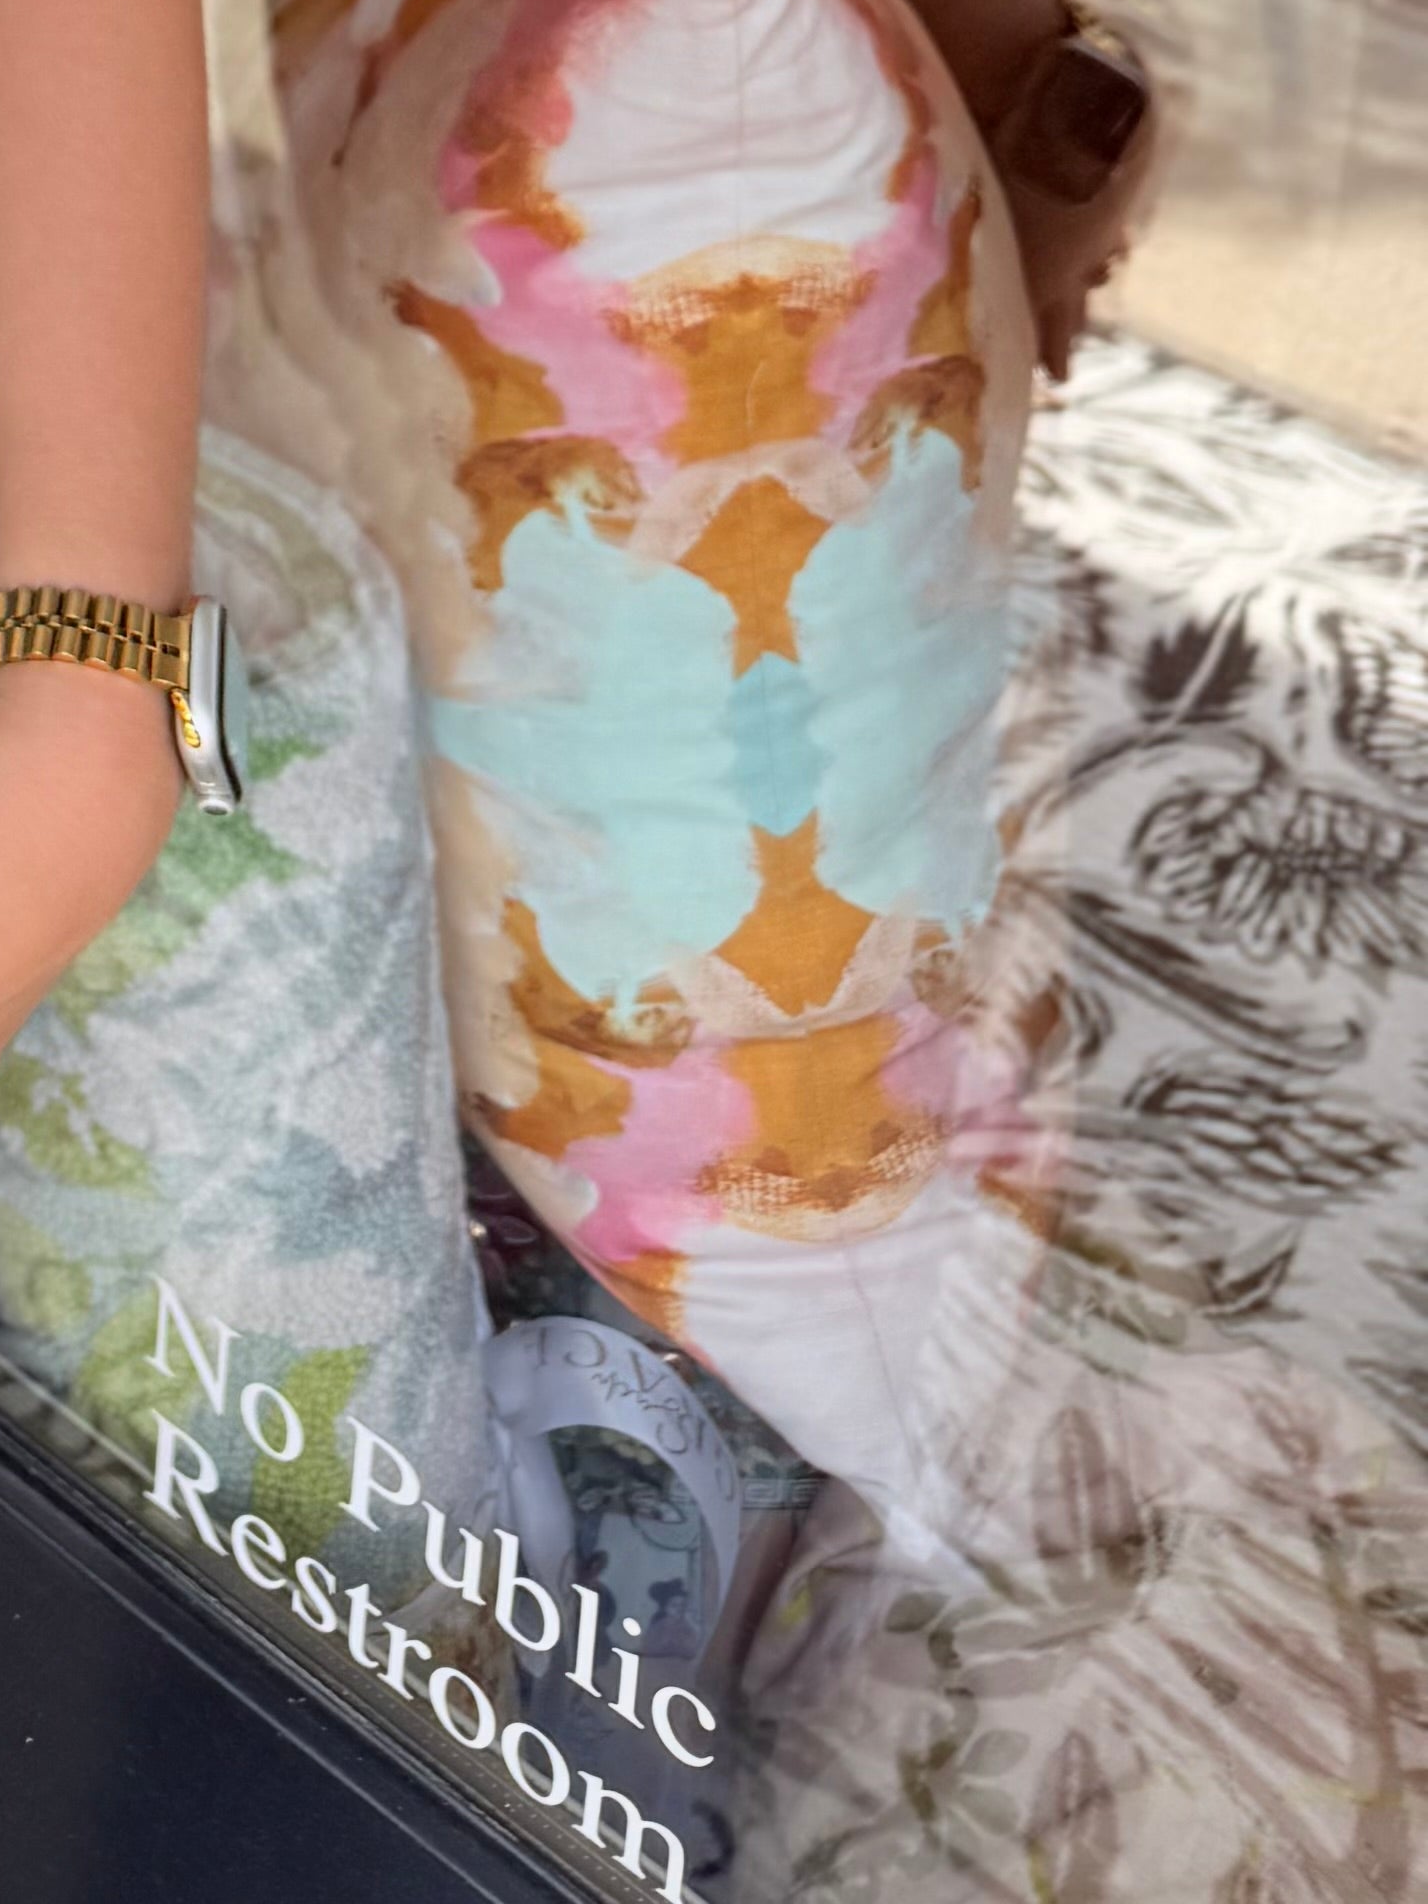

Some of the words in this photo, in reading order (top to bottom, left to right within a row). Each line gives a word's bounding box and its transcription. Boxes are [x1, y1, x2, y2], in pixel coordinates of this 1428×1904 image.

[144, 1409, 685, 1904] Restroom
[145, 1274, 305, 1463] No
[339, 1417, 717, 1768] Public
